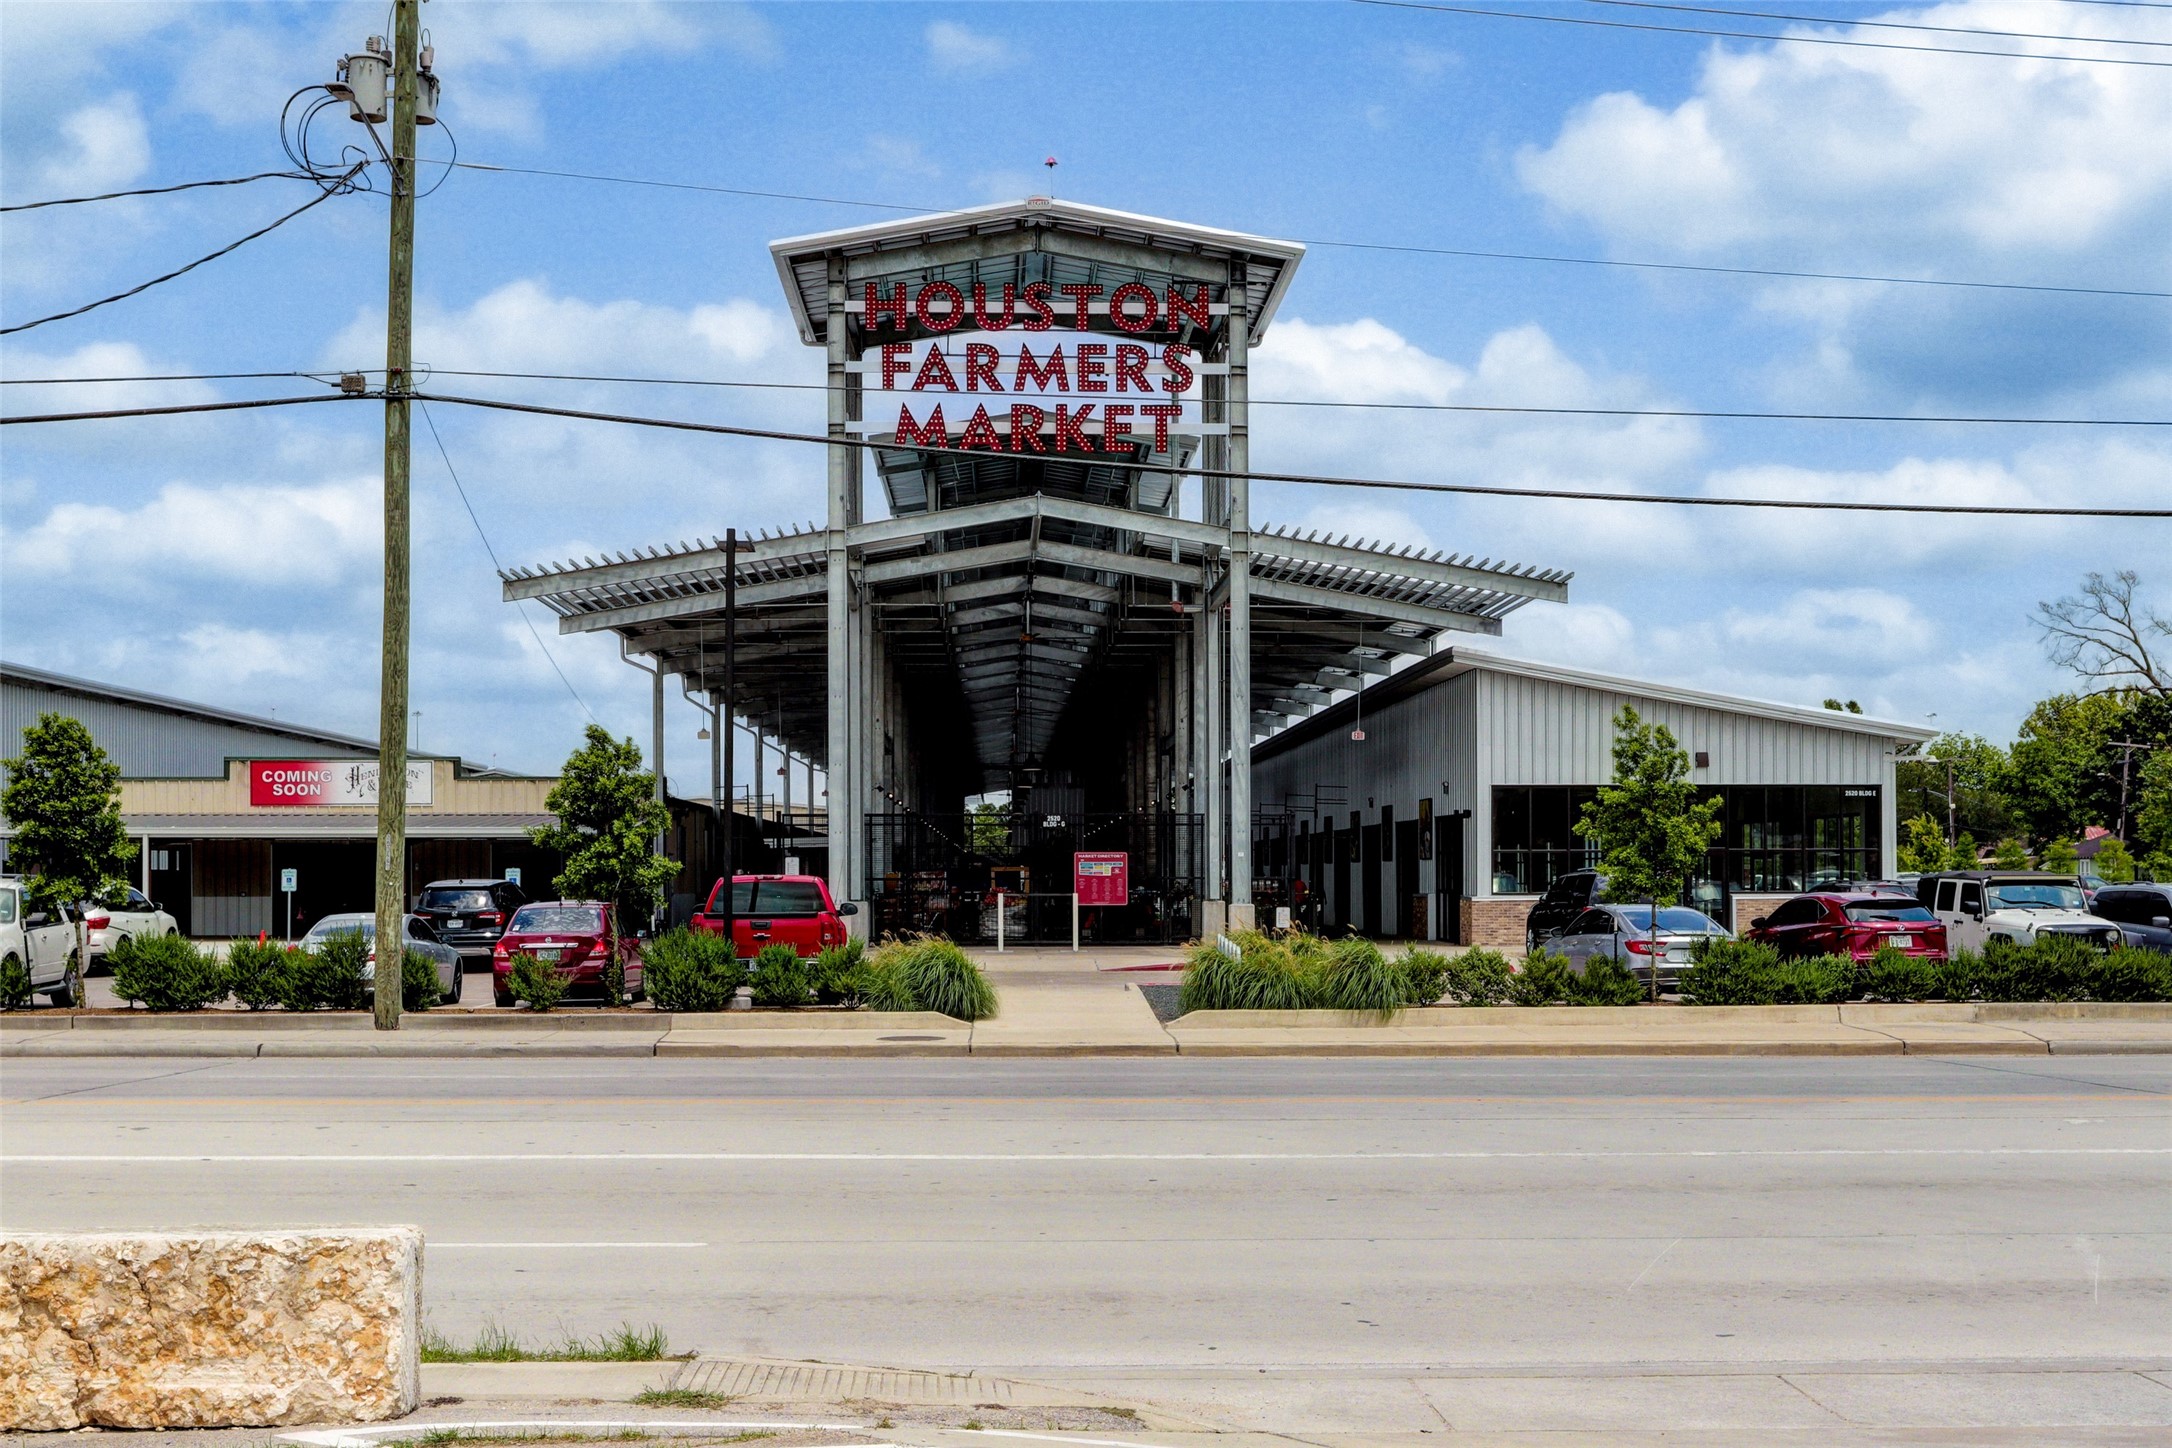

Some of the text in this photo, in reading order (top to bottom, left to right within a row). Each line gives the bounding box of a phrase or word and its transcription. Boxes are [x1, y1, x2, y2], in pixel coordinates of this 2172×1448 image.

[865, 281, 1210, 333] HOUSTON
[881, 342, 1194, 393] FARMERS
[894, 402, 1183, 453] MARKET
[261, 770, 333, 783] COMING
[272, 783, 322, 796] SOON
